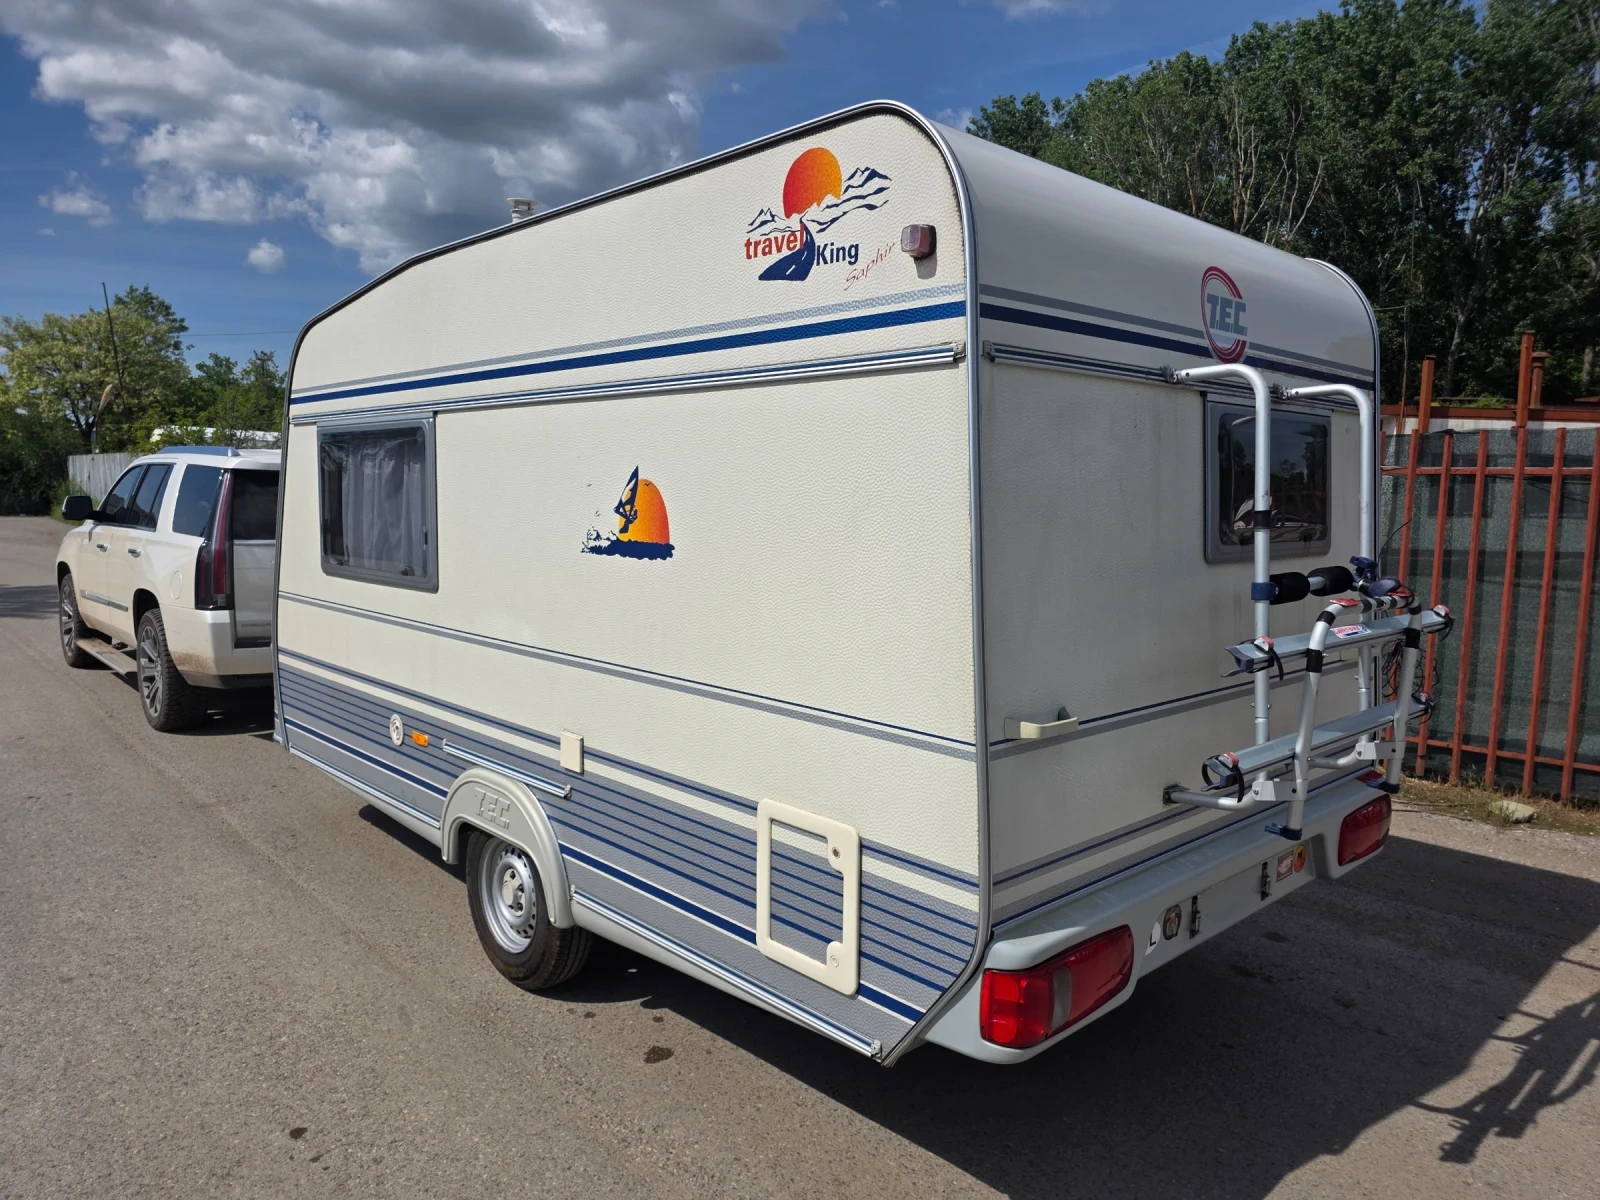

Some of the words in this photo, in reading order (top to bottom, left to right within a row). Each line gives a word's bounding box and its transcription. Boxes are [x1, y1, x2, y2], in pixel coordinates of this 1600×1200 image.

[744, 222, 805, 260] travel
[815, 241, 859, 266] King
[843, 241, 896, 291] Saphir
